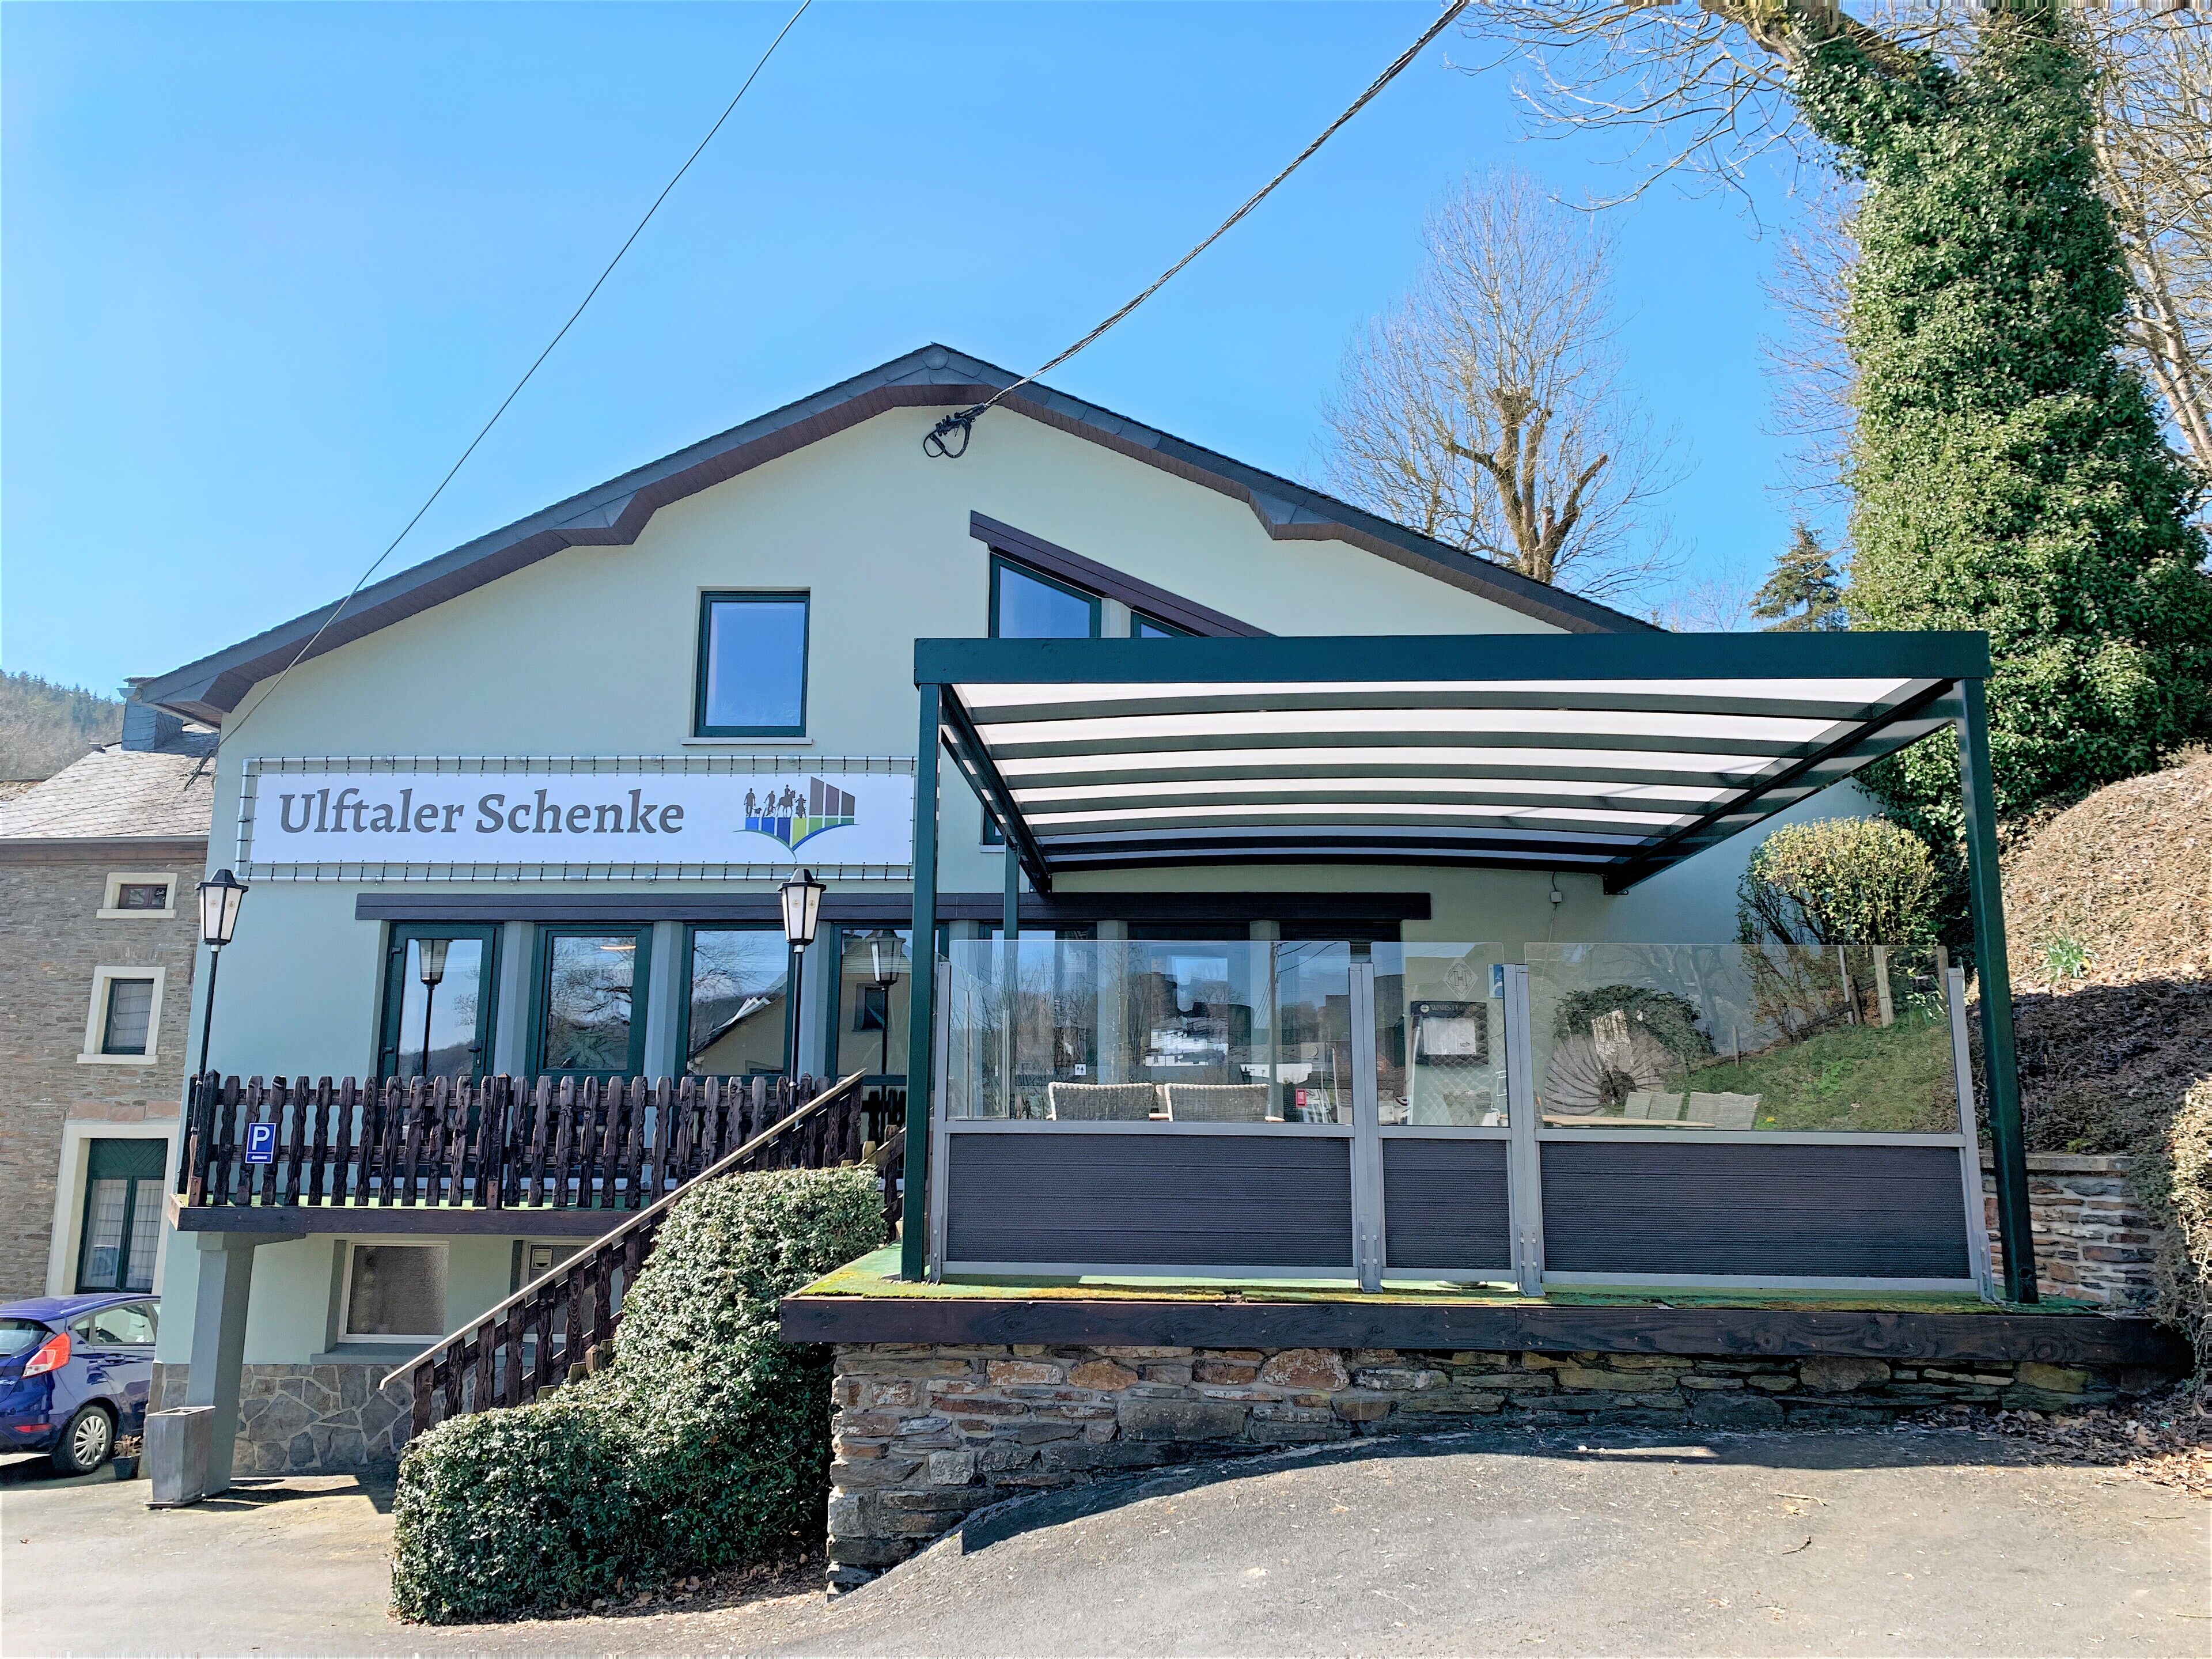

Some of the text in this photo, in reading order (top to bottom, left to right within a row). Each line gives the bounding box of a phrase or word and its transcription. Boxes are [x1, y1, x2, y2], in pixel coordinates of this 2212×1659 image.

[279, 787, 684, 834] Ulftaler Schenke
[252, 1126, 270, 1150] P
